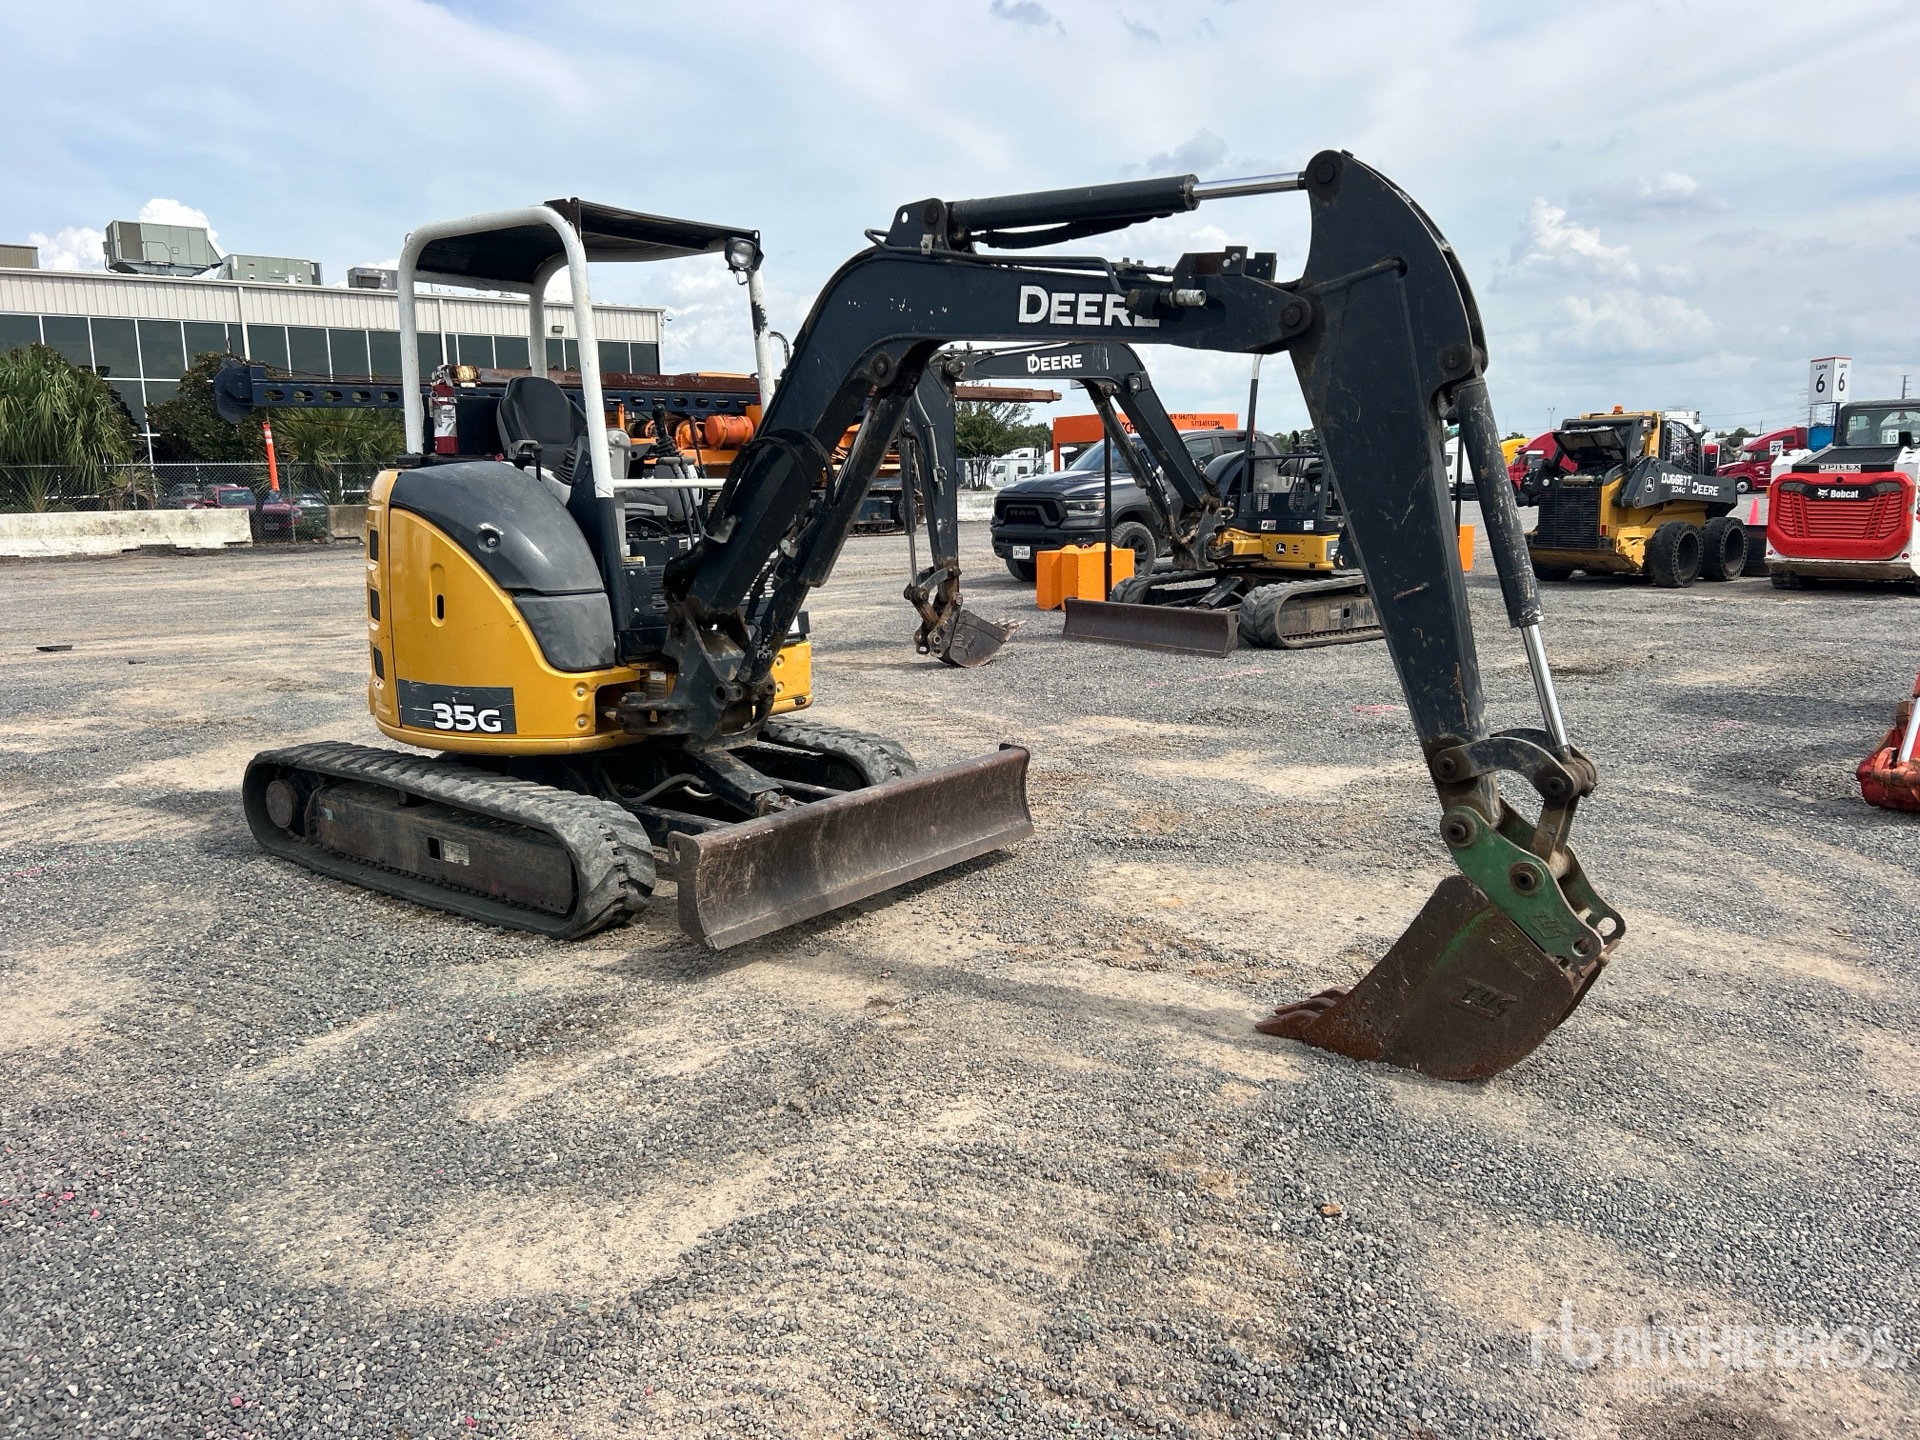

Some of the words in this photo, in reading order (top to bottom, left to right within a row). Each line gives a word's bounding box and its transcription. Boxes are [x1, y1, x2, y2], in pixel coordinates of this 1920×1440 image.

[1018, 285, 1160, 328] DEER
[1026, 354, 1083, 373] DEERE
[1815, 373, 1825, 393] 6
[1838, 372, 1845, 392] 6
[1691, 481, 1719, 496] DEERE
[1830, 489, 1859, 499] Bobcat
[432, 702, 503, 733] 35G
